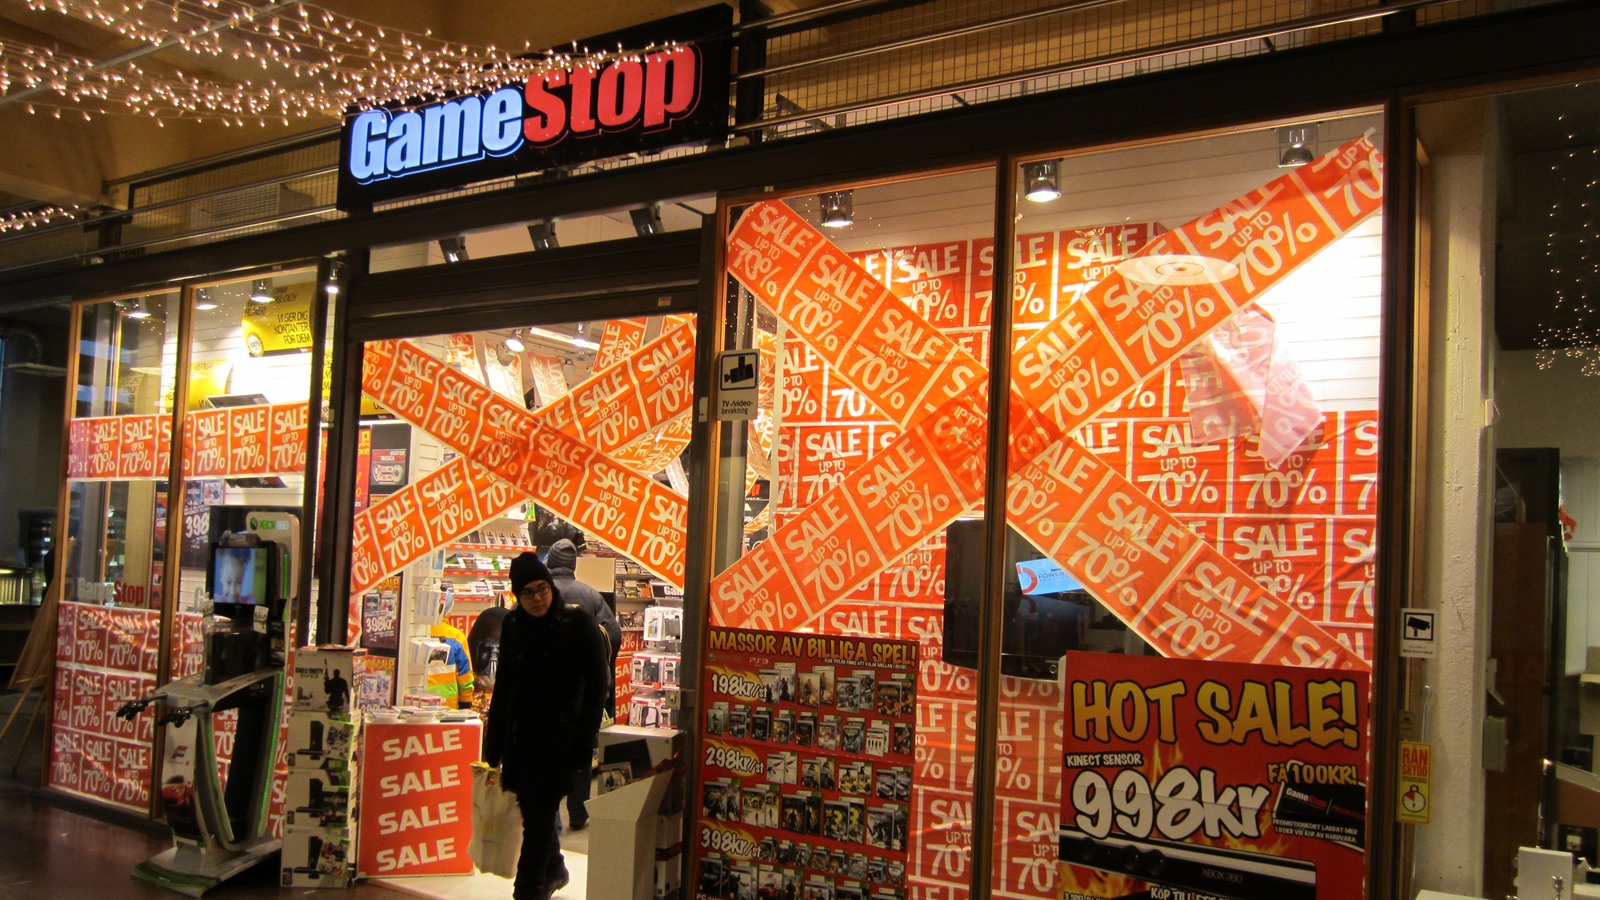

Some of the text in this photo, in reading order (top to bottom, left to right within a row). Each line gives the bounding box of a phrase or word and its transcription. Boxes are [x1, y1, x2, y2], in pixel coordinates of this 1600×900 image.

[350, 44, 702, 185] GameStop
[750, 206, 814, 258] SALE
[732, 238, 782, 298] 70%
[896, 246, 960, 282] SALE
[1221, 211, 1318, 294] 70%
[809, 254, 876, 312] SALE
[912, 278, 942, 293] UP TO
[1102, 238, 1178, 322] SALE
[788, 288, 844, 352] 70%
[1136, 284, 1174, 321] UP TO
[872, 308, 944, 368] SALE
[1124, 286, 1216, 365] 70%
[399, 350, 439, 384] SALE
[638, 330, 692, 383] SALE
[1018, 310, 1093, 390] SALE
[442, 376, 485, 411] SALE
[579, 367, 630, 418] SALE
[848, 344, 909, 410] 70%
[1039, 355, 1120, 432] 70%
[389, 380, 424, 417] 70%
[125, 419, 152, 444] SALE
[198, 413, 225, 440] SALE
[233, 410, 265, 437] SALE
[274, 406, 308, 434] SALE
[432, 406, 470, 445] 70%
[488, 404, 534, 440] SALE
[588, 405, 638, 450] 70%
[121, 450, 151, 474] 70%
[197, 446, 225, 473] 70%
[232, 443, 264, 471] 70%
[272, 441, 306, 470] 70%
[539, 434, 586, 470] SALE
[805, 428, 863, 462] SALE
[593, 463, 642, 502] SALE
[818, 460, 846, 473] UP TO
[856, 437, 926, 508] SALE
[1159, 456, 1197, 472] UP TO
[421, 463, 463, 508] SALE
[528, 464, 570, 506] 70%
[1137, 468, 1219, 508] 70%
[1239, 468, 1327, 510] 70%
[259, 520, 276, 530] XBOX
[376, 491, 416, 534] SALE
[430, 499, 474, 542] 70%
[581, 496, 626, 540] 70%
[649, 495, 687, 533] SAL
[785, 494, 848, 562] SALE
[874, 483, 950, 552] 70%
[1096, 491, 1186, 564] SALE
[383, 526, 424, 568] 70%
[639, 529, 684, 576] 70%
[1232, 522, 1318, 561] SALE
[718, 546, 778, 613] SALE
[802, 542, 870, 604] 70%
[1066, 531, 1144, 608] 70%
[1184, 561, 1278, 636] SALE
[80, 610, 108, 630] SALE
[77, 640, 102, 661] 70%
[110, 644, 136, 665] 70%
[709, 630, 778, 655] MASSOR
[780, 637, 805, 657] AV
[807, 639, 869, 662] BILLIGA
[872, 640, 916, 666] SPEL!
[108, 680, 136, 701] SALE
[73, 705, 99, 727] 70%
[1071, 679, 1359, 749] HOT SALE!
[86, 740, 111, 761] SALE
[119, 748, 147, 769] SALE
[382, 728, 463, 762] SALE
[1066, 753, 1143, 767] KINECT SENSOR
[84, 770, 110, 792] 70%
[118, 778, 148, 800] 70%
[379, 764, 461, 798] SALE
[1268, 763, 1357, 785] FÅ 100KR!
[377, 801, 459, 836] SALE
[375, 837, 457, 873] SALE
[1150, 886, 1170, 900] KÖP
